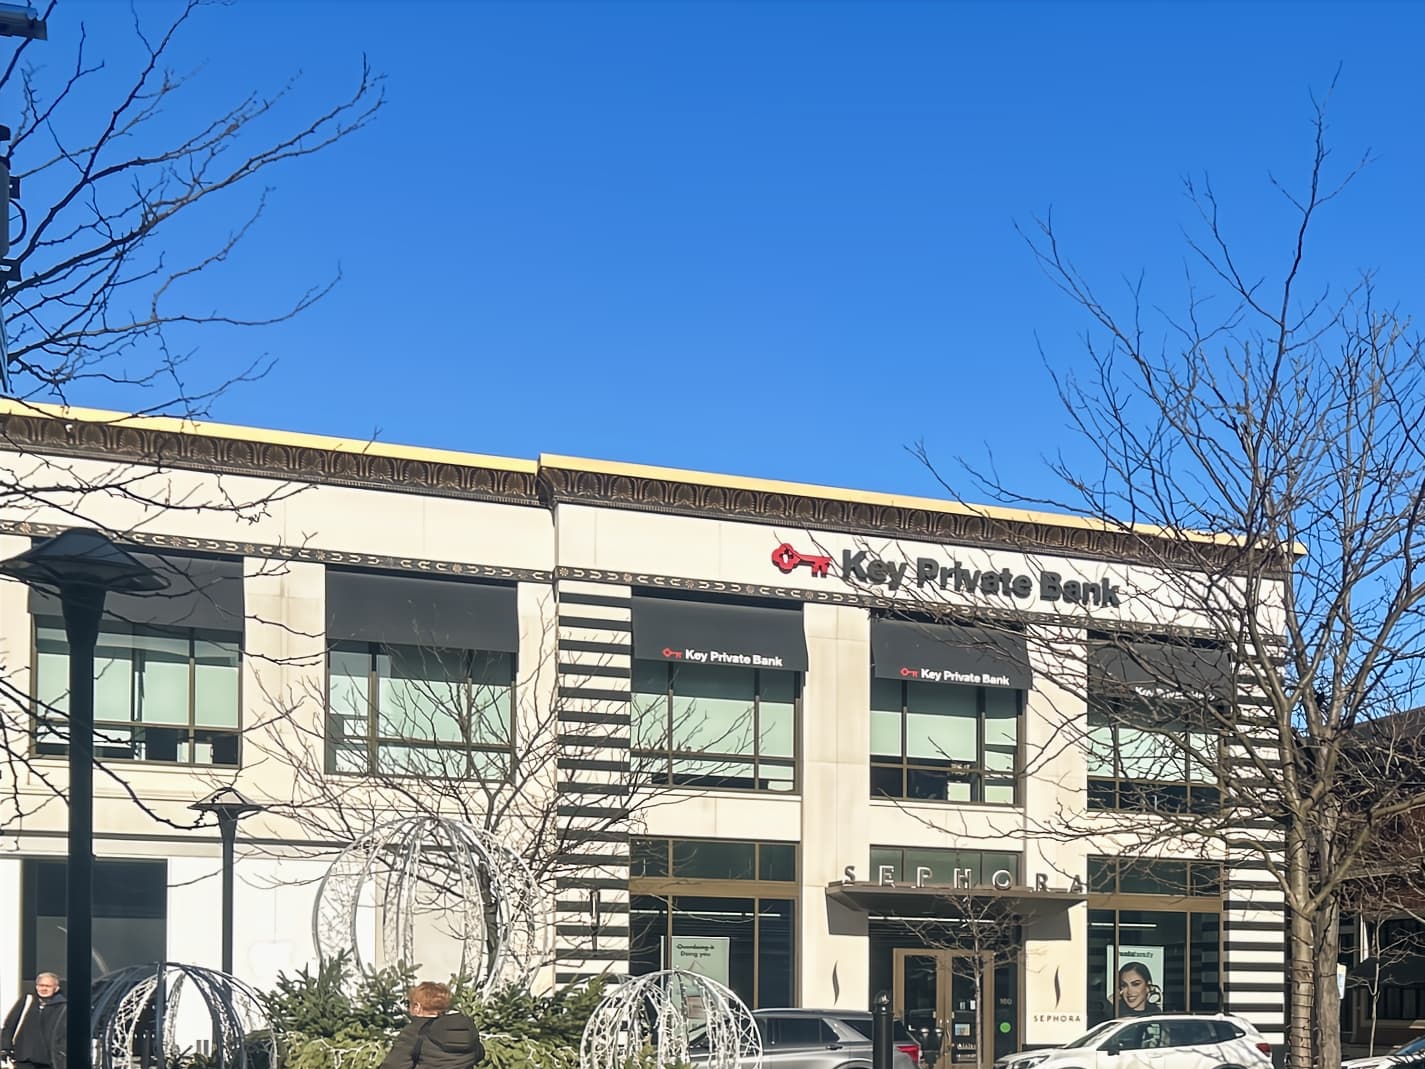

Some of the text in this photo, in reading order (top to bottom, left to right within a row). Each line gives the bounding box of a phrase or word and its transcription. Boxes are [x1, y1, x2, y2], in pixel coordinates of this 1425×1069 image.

[841, 548, 1121, 608] Key Private Bank
[685, 649, 783, 667] Key Private Bank
[921, 668, 1010, 686] Key Private Bank
[842, 865, 1087, 894] SEPHORA
